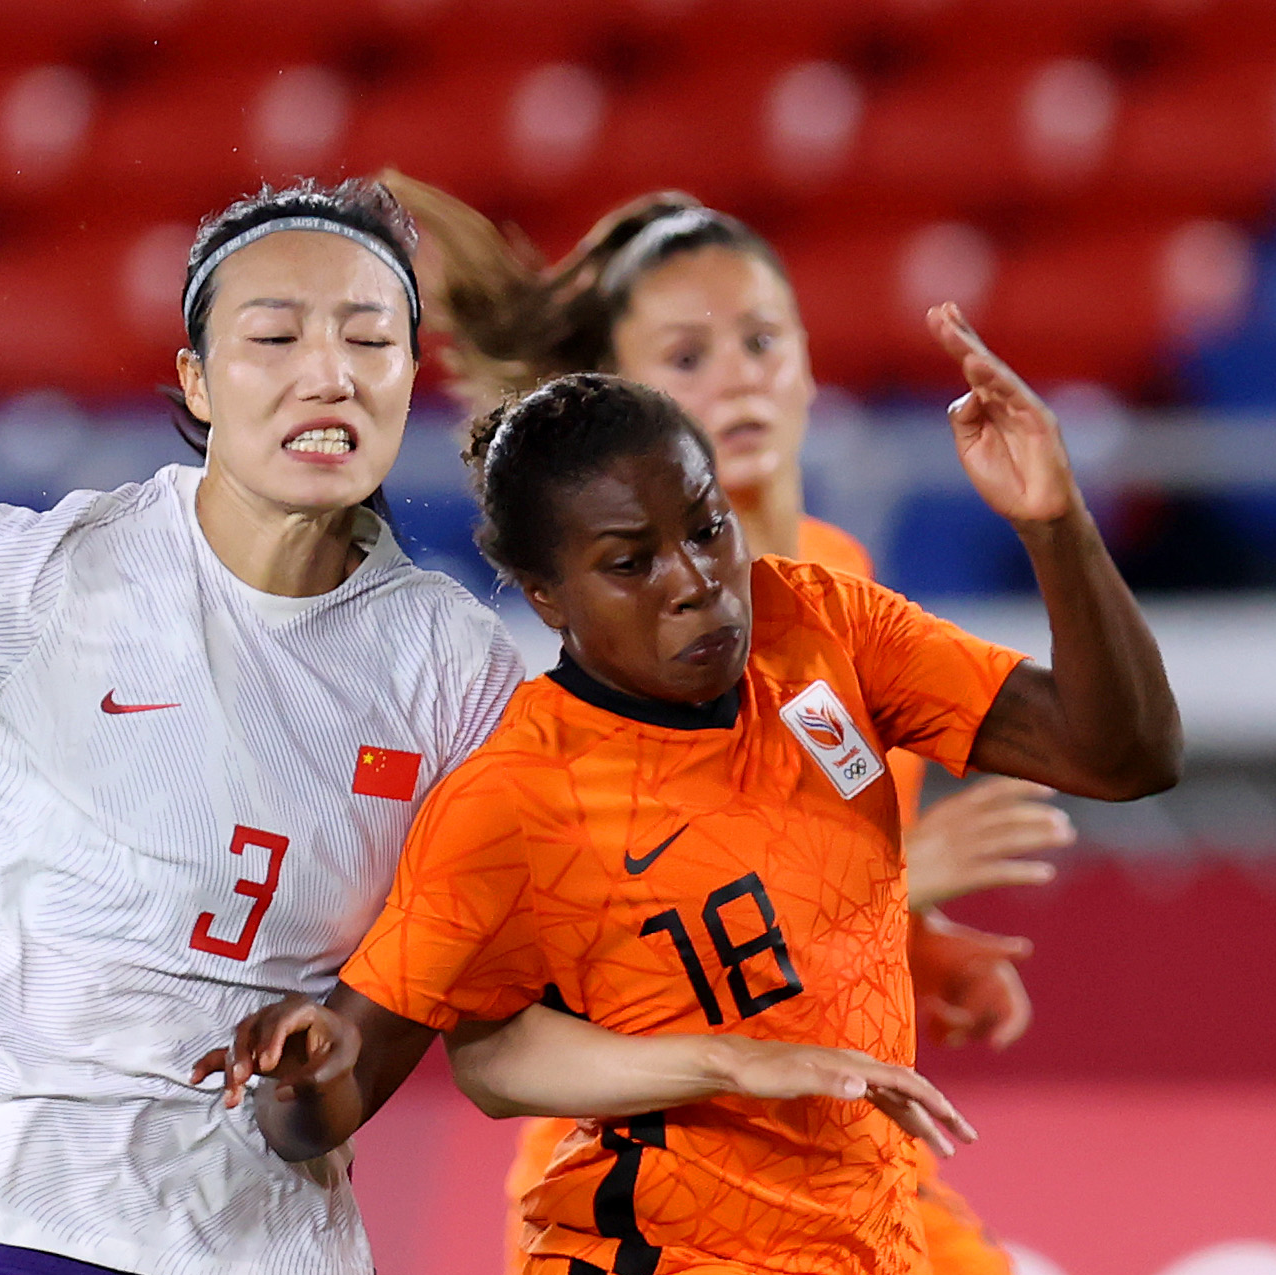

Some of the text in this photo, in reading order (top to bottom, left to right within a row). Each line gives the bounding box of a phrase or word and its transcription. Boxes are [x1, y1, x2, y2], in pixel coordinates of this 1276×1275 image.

[323, 220, 340, 233] DO
[189, 823, 290, 961] 3
[638, 871, 804, 1026] 18
